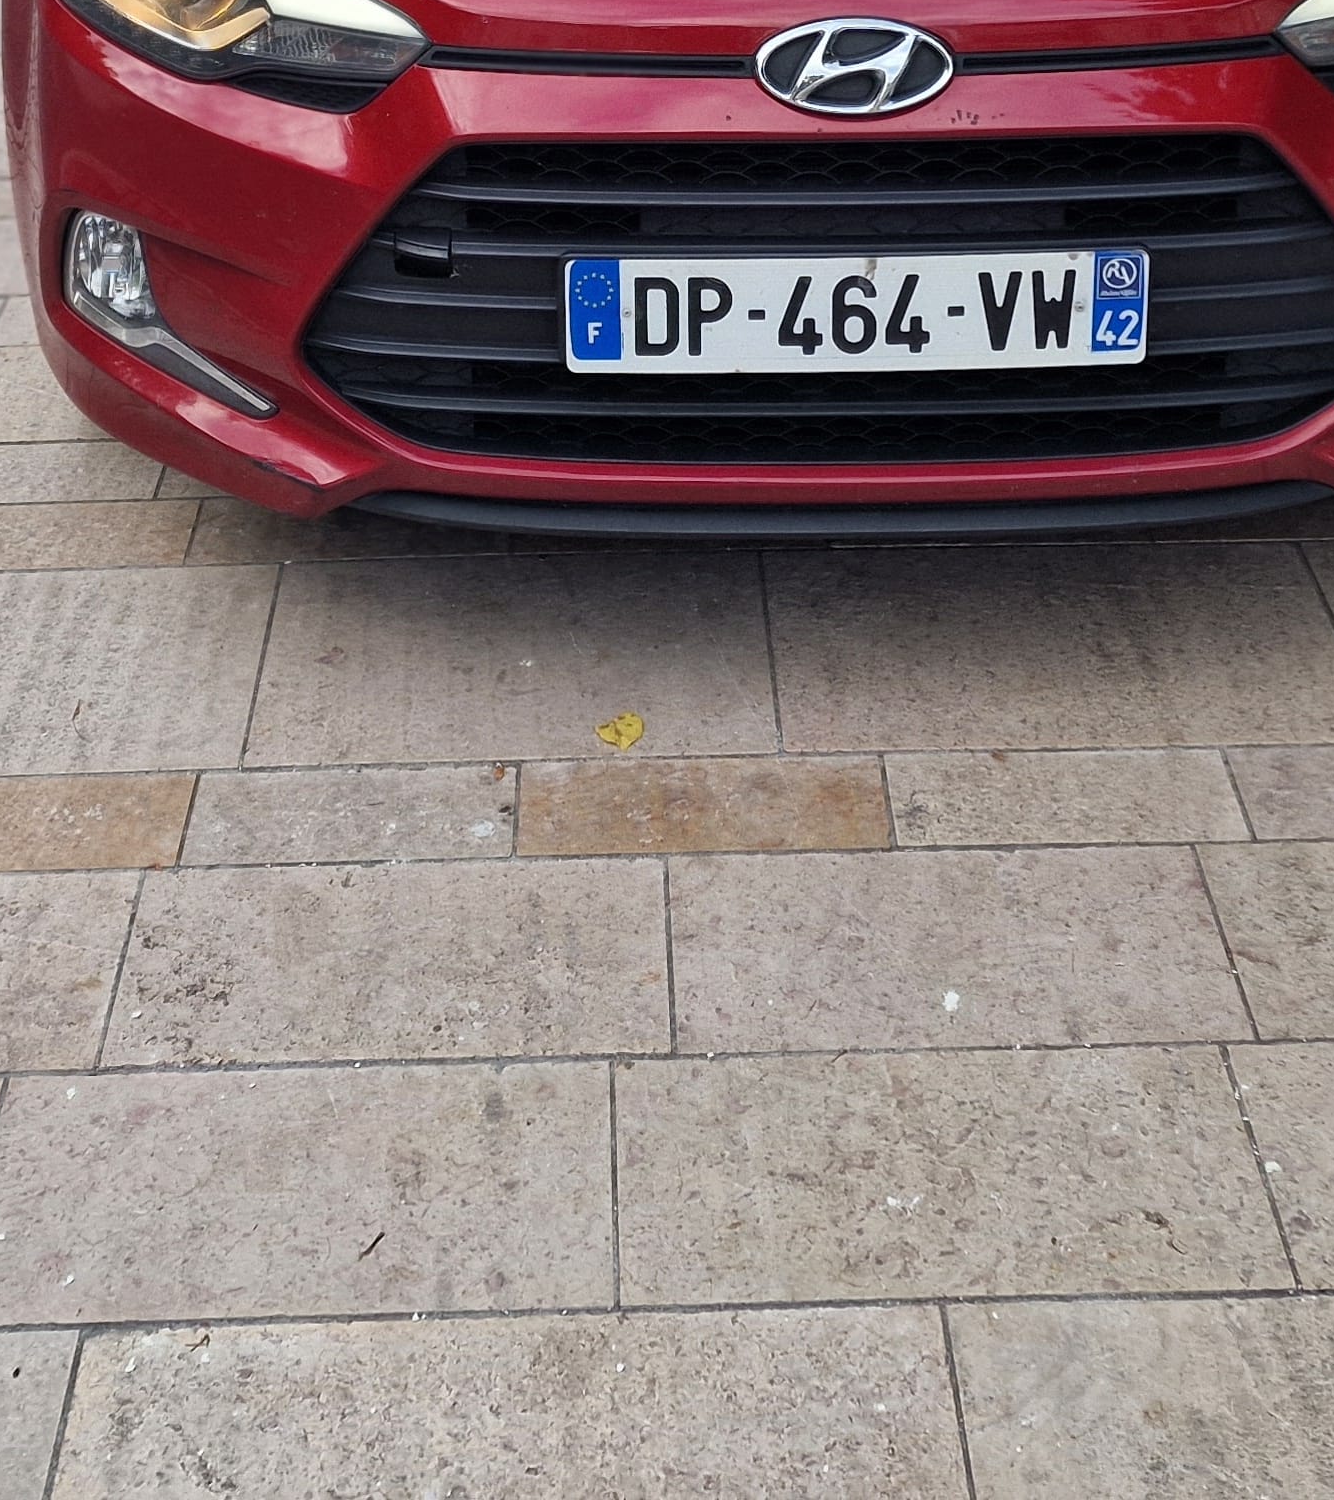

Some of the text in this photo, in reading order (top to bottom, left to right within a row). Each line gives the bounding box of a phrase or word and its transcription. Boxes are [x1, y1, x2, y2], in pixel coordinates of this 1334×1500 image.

[634, 269, 1076, 357] DP-464-VW
[1096, 309, 1139, 346] 42
[587, 322, 603, 345] F
